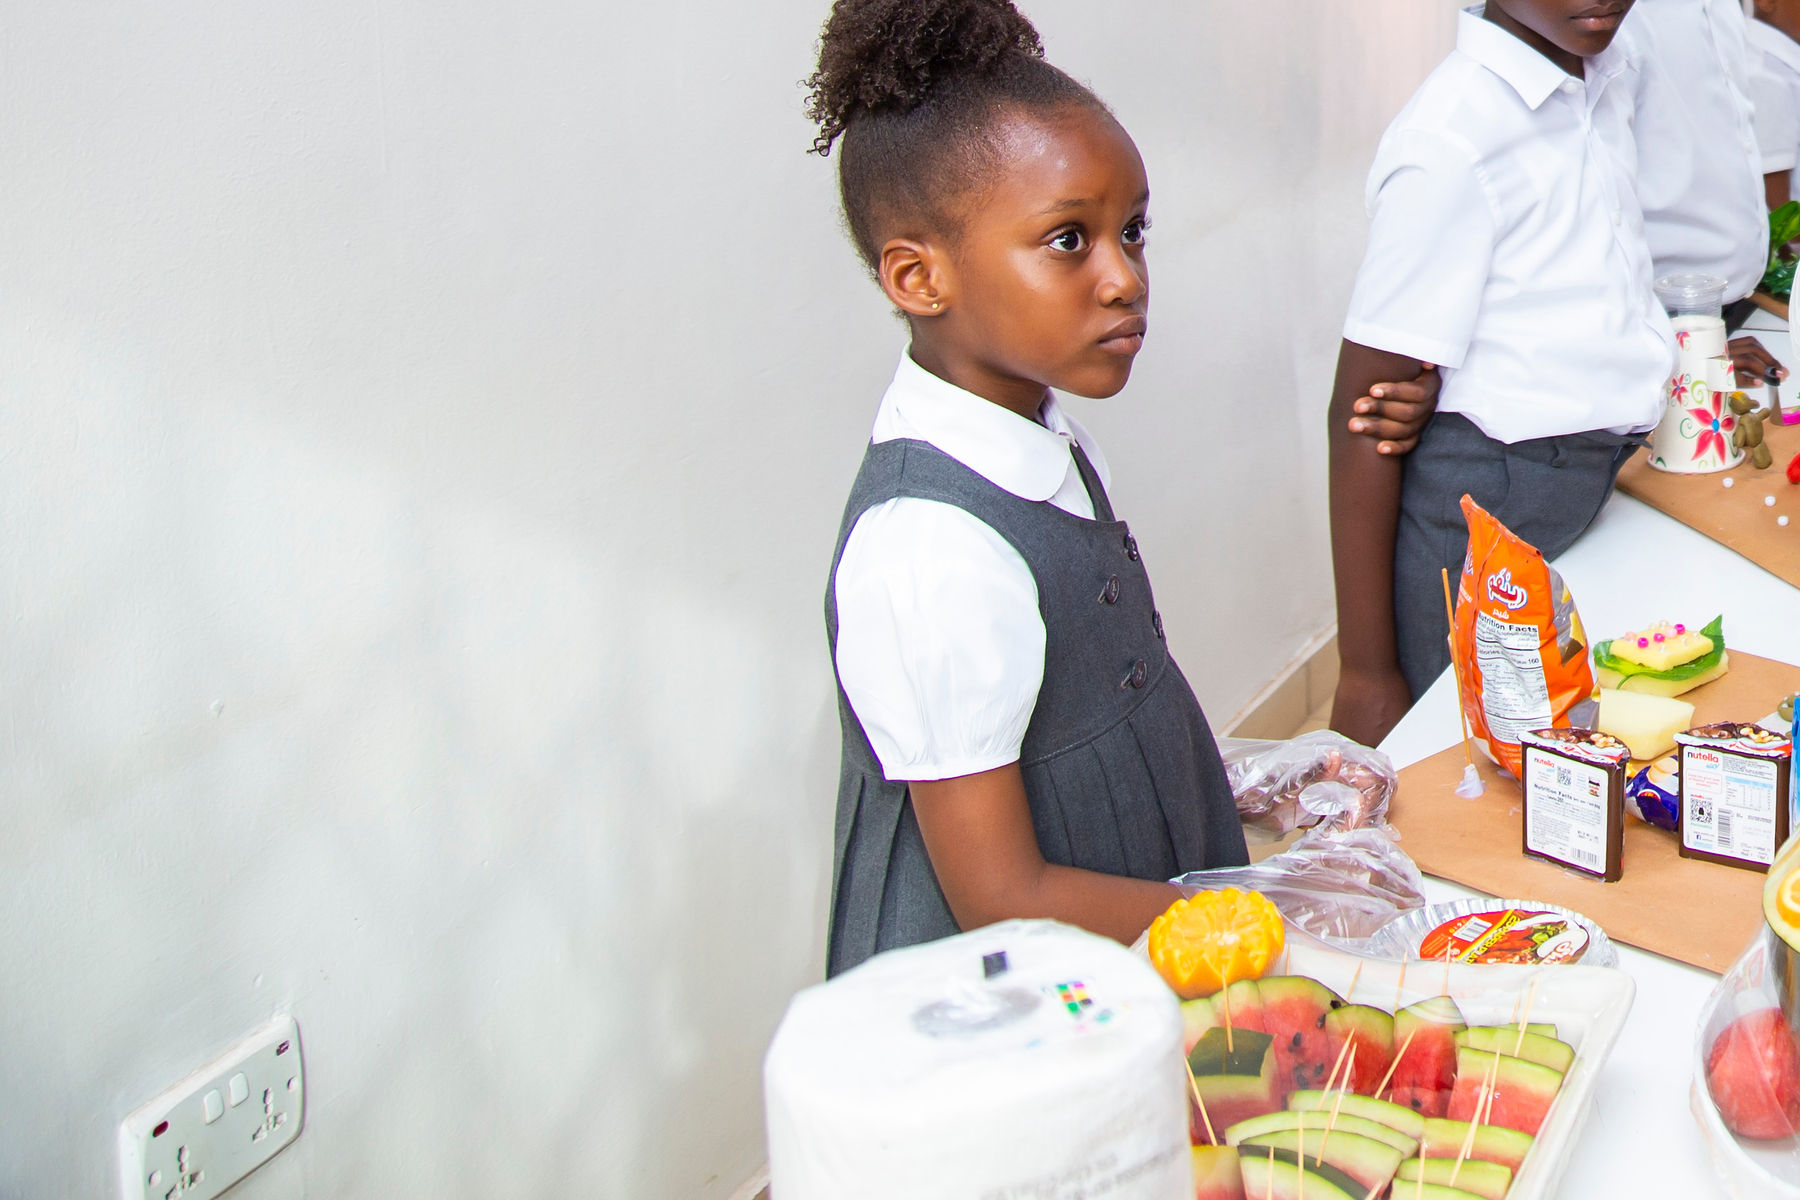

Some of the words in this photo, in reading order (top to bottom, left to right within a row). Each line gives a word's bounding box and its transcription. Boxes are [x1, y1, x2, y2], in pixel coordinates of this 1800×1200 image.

[1508, 624, 1538, 633] Facts
[1534, 757, 1555, 769] nutella
[1687, 751, 1719, 764] nutella
